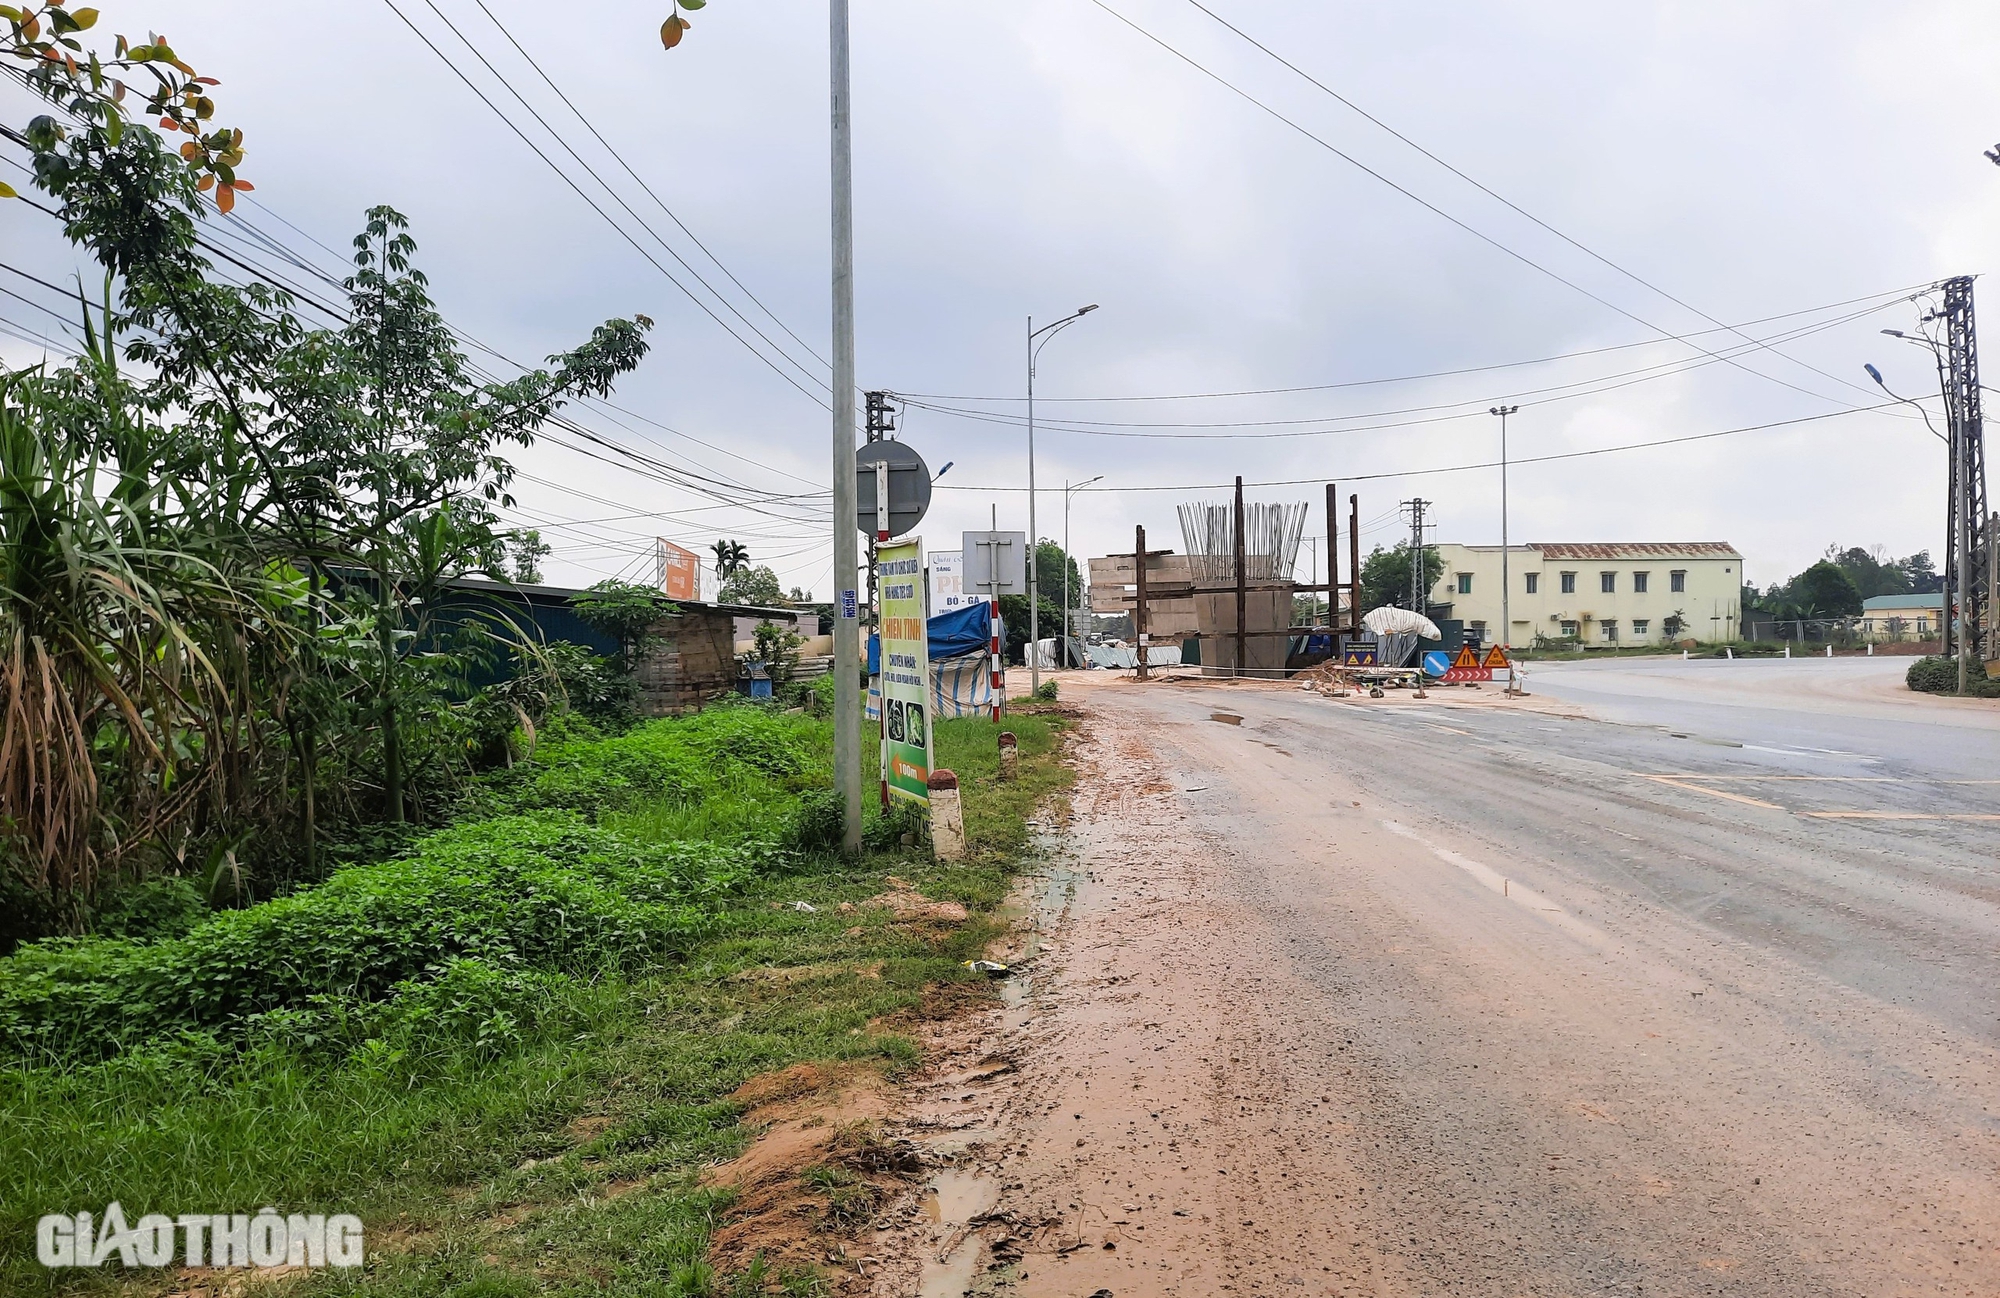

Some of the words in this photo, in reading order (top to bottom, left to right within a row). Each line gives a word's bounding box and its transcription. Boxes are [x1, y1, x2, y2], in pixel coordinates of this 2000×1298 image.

[936, 575, 963, 593] PH
[946, 594, 959, 606] BÒ
[967, 595, 980, 605] GÀ
[882, 607, 902, 640] CHIẾN
[889, 652, 904, 668] CHUYÊN
[898, 763, 918, 780] 100m
